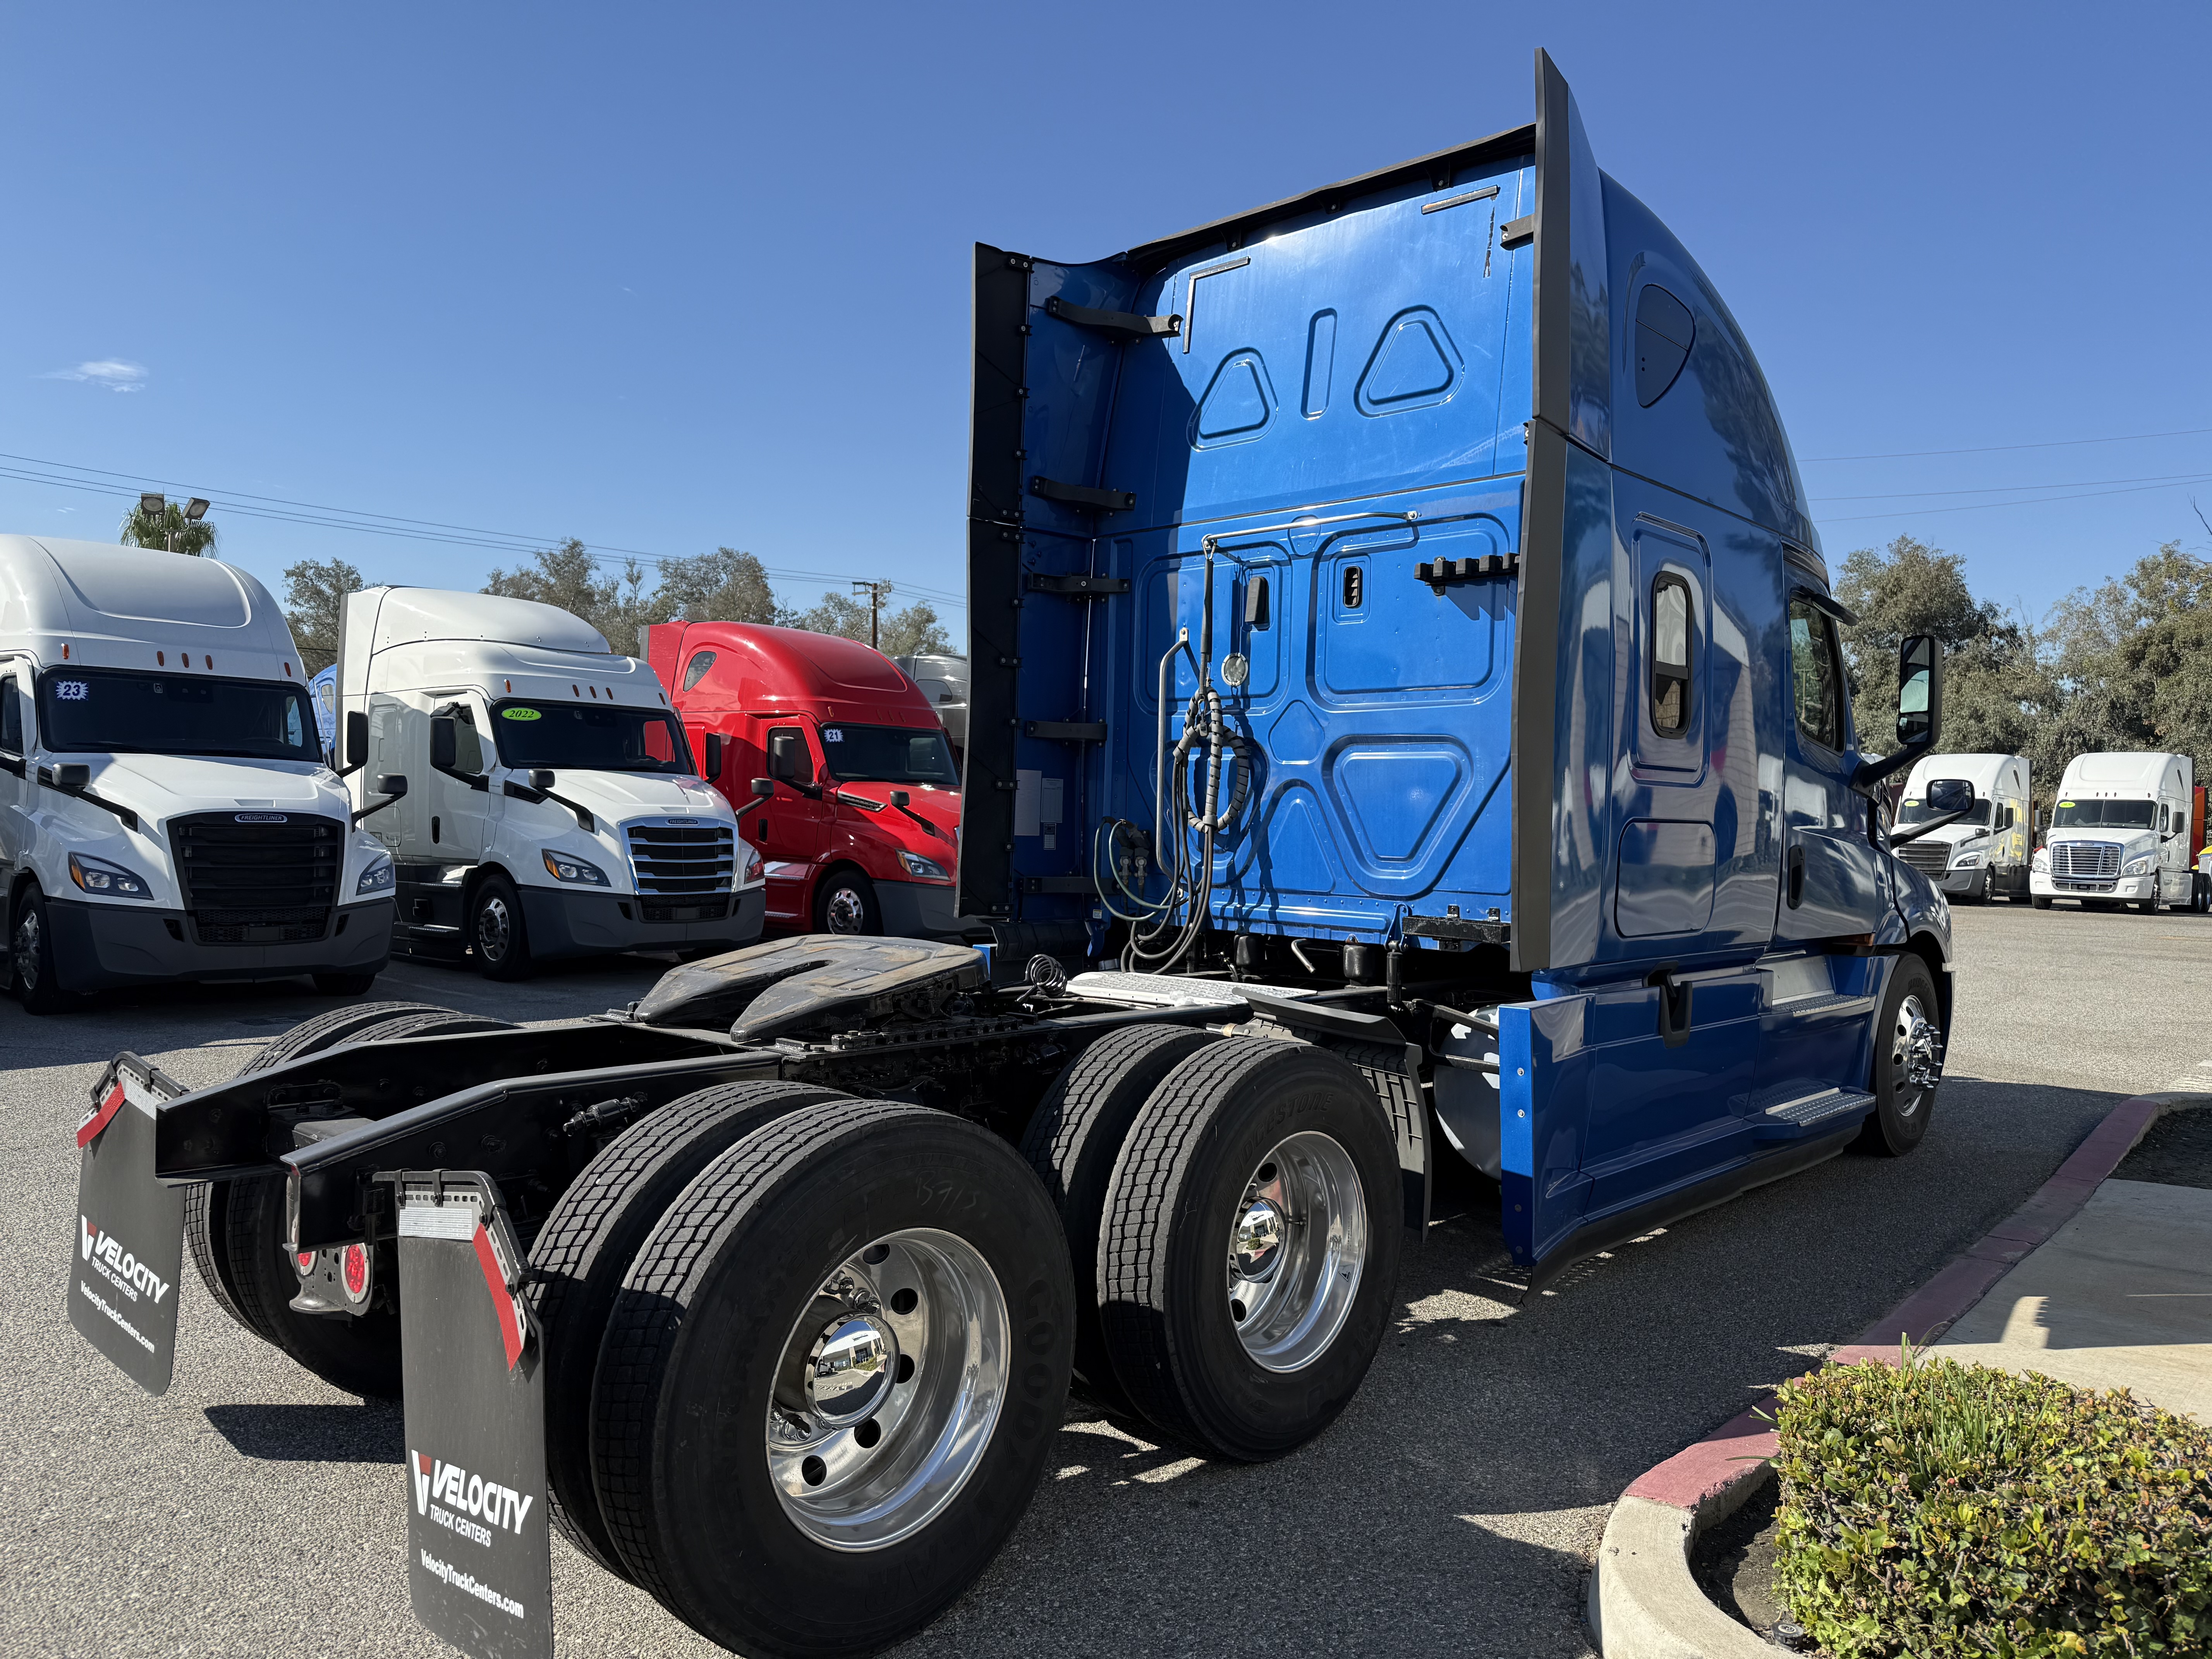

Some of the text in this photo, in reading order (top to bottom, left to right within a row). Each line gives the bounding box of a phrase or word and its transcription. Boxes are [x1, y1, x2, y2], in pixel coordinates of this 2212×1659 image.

[63, 684, 80, 696] 23
[829, 731, 838, 739] 21
[1212, 1090, 1334, 1224] BRIDGESTONE
[92, 1256, 138, 1302] TRUCK CENTERS
[95, 1230, 170, 1304] VELOCITY
[81, 1280, 155, 1353] VelocityTruckCenters.com
[430, 1504, 491, 1547] TRUCK CENTERS
[431, 1459, 533, 1534] VELOCITY
[421, 1548, 524, 1619] VelocityTruckCenters.com
